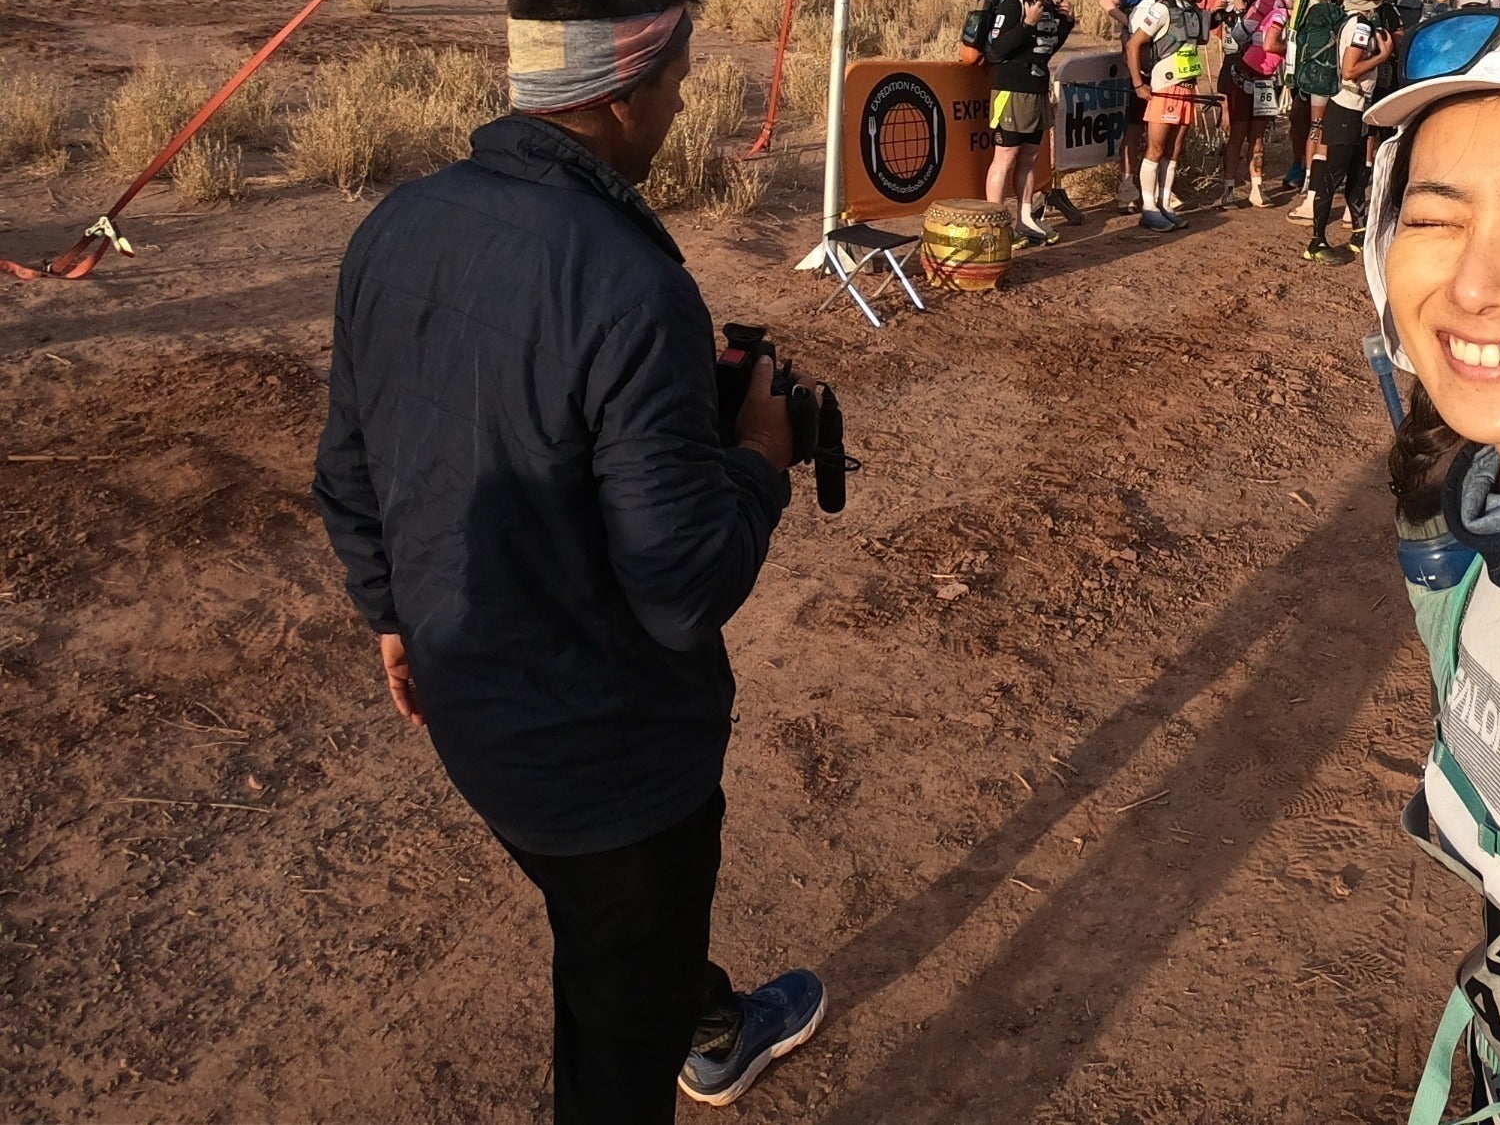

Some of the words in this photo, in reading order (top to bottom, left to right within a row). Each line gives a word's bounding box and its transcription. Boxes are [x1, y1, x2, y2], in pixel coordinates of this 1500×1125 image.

[870, 80, 910, 113] EXPEDITION
[910, 82, 935, 109] FOODS
[1259, 92, 1273, 103] 66
[951, 98, 991, 121] EXPE
[1065, 101, 1126, 158] thep
[969, 131, 995, 152] FO
